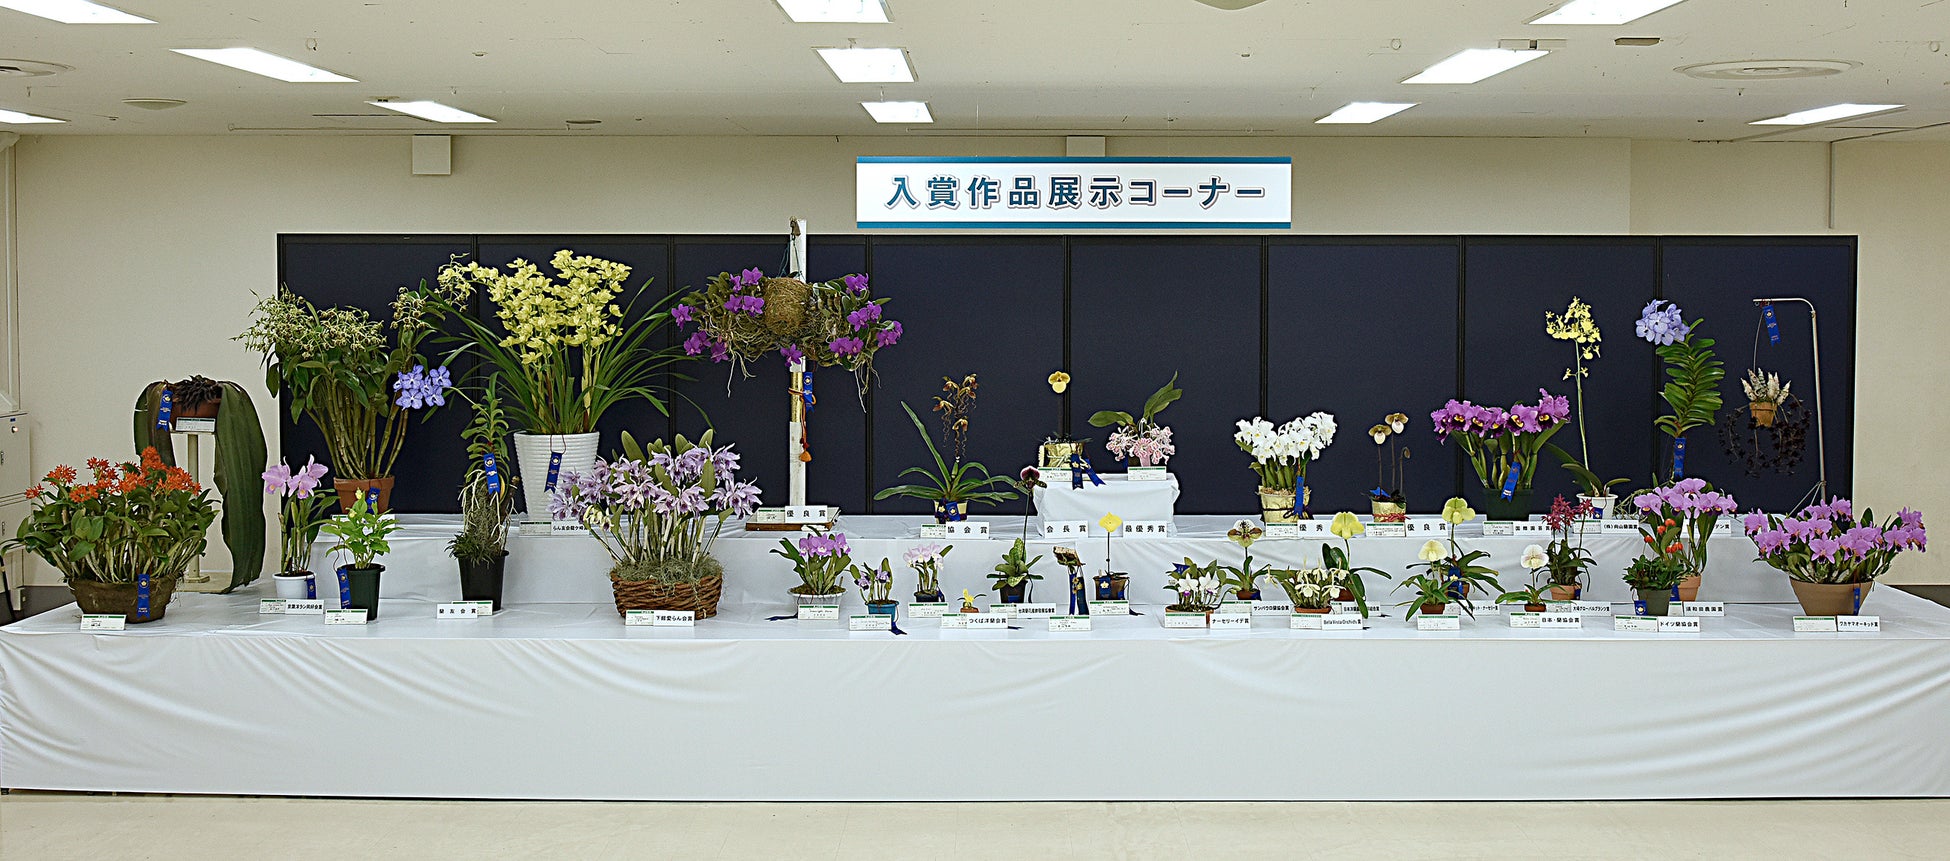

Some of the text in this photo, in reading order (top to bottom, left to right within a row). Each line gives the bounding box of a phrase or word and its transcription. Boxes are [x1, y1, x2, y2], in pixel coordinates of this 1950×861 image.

[885, 175, 1263, 208] 入賞作品展示コーナー
[786, 509, 826, 518] 優良賞
[948, 525, 988, 534] 協会賞
[1046, 525, 1086, 533] 会長賞
[1125, 525, 1166, 533] 最優秀賞
[1299, 524, 1324, 532] 優秀
[1407, 523, 1446, 531] 優良賞
